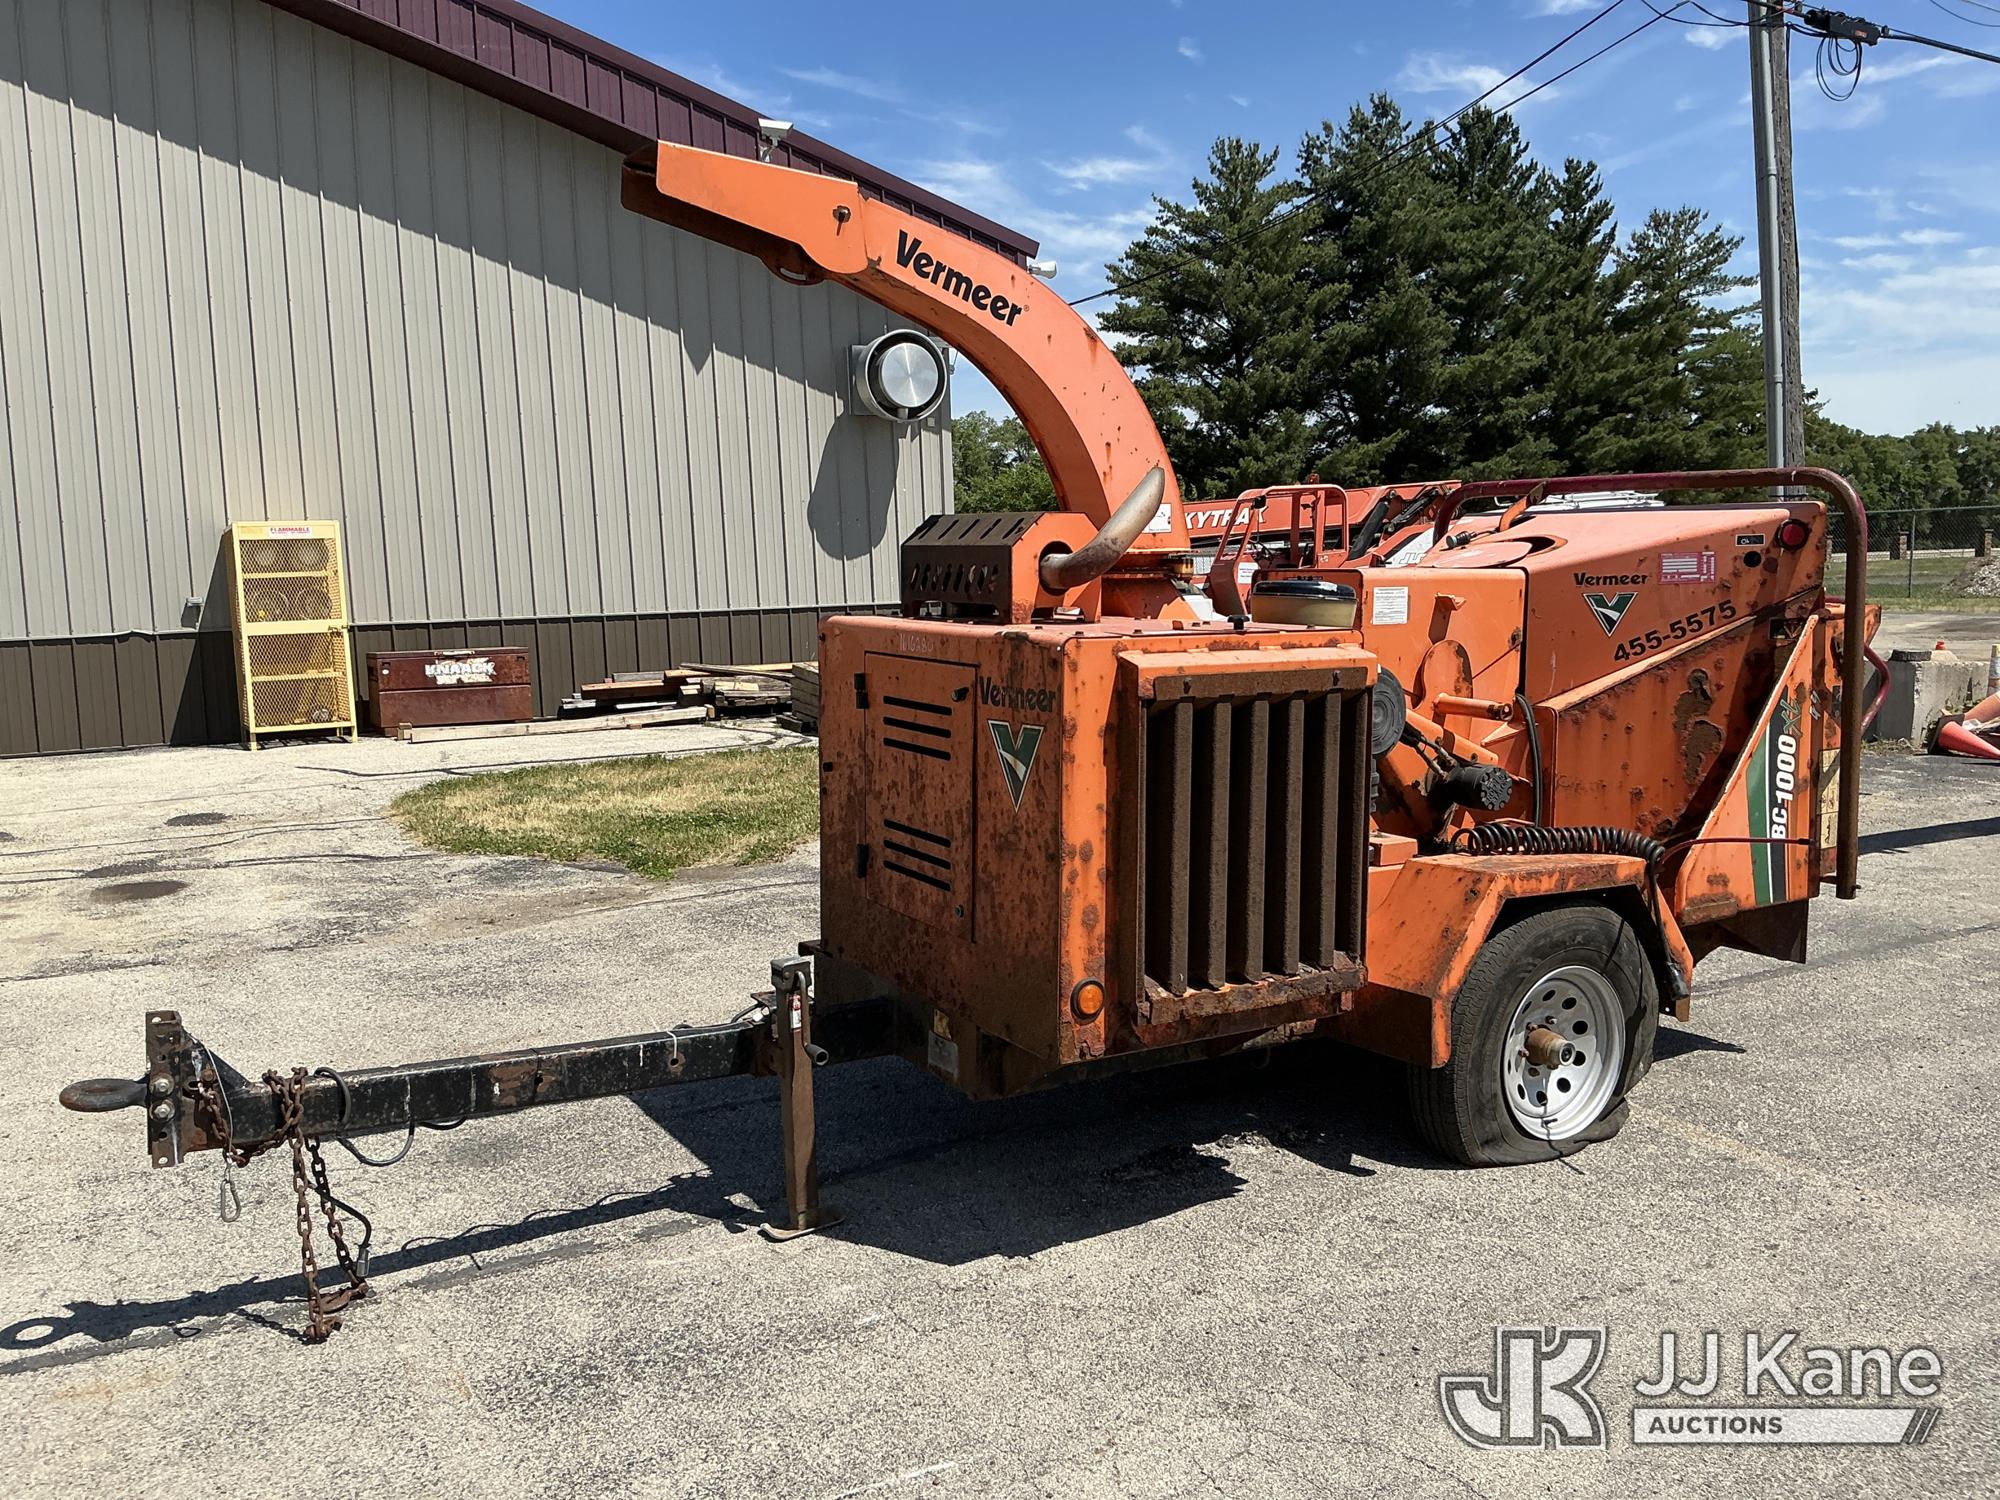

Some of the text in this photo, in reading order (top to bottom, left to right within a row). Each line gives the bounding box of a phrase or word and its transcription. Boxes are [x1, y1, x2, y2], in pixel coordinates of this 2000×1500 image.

[896, 229, 1022, 326] Vermeer
[1573, 572, 1648, 586] Vermeer
[1614, 600, 1737, 661] 455-5575
[979, 676, 1057, 713] Vermeer
